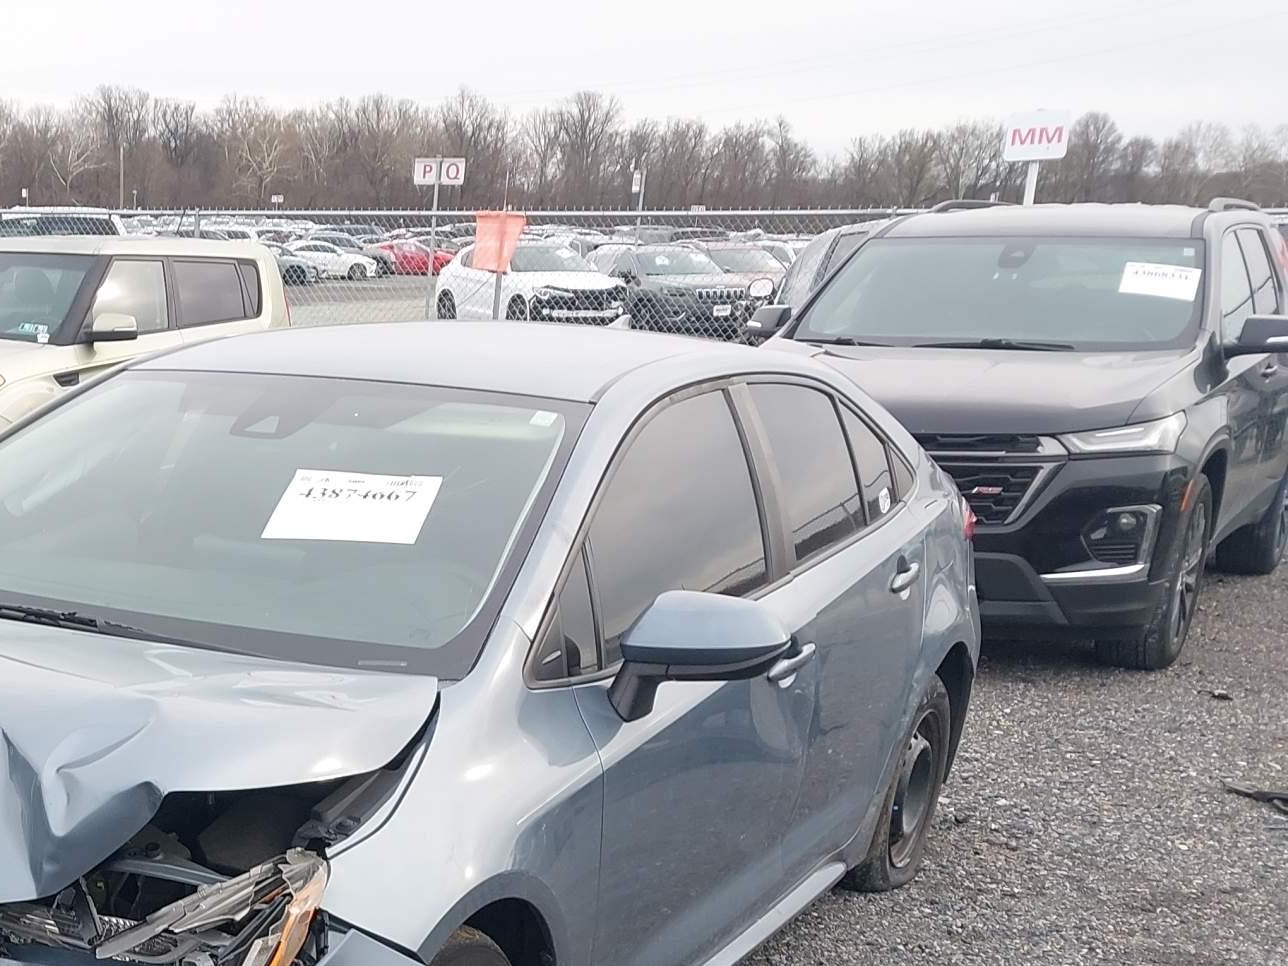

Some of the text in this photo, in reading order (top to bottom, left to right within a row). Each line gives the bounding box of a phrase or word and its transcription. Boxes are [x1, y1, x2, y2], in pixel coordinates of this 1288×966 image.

[1010, 125, 1065, 146] MM
[422, 163, 460, 180] P Q
